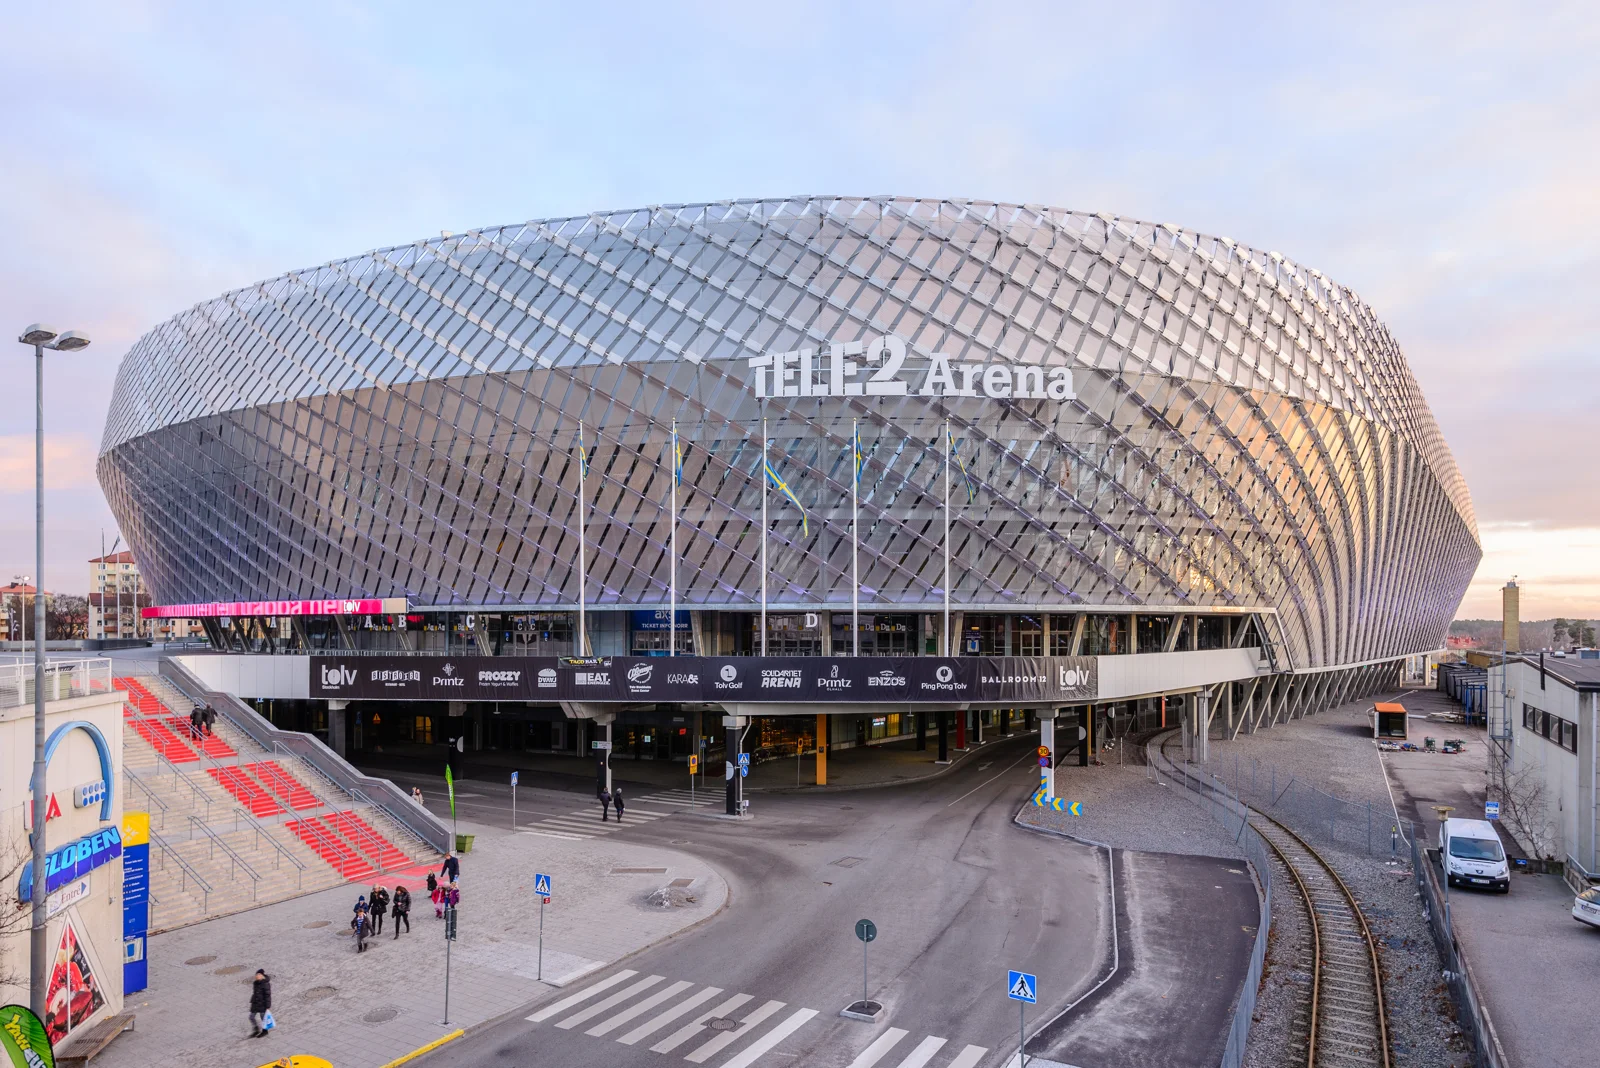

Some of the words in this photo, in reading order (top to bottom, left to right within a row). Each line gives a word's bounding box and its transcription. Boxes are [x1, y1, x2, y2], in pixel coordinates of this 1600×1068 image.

[748, 334, 907, 399] TELE2
[919, 352, 1077, 400] Arena
[343, 600, 361, 613] tolv
[270, 617, 277, 628] A
[364, 615, 373, 628] A
[398, 615, 406, 628] B
[466, 615, 475, 628] C
[805, 613, 818, 628] D
[321, 664, 358, 686] tolv
[432, 676, 465, 686] Printz
[478, 670, 521, 681] FROZZY
[587, 672, 611, 682] EAT.
[981, 675, 1037, 683] BALLROOM
[1039, 675, 1047, 683] 12
[1060, 665, 1090, 686] tolv
[761, 677, 802, 688] ARENA
[817, 678, 852, 688] Printz
[921, 682, 936, 690] Ping
[936, 682, 953, 690] Pong
[953, 682, 968, 690] Tolv
[29, 827, 122, 888] LOBEN
